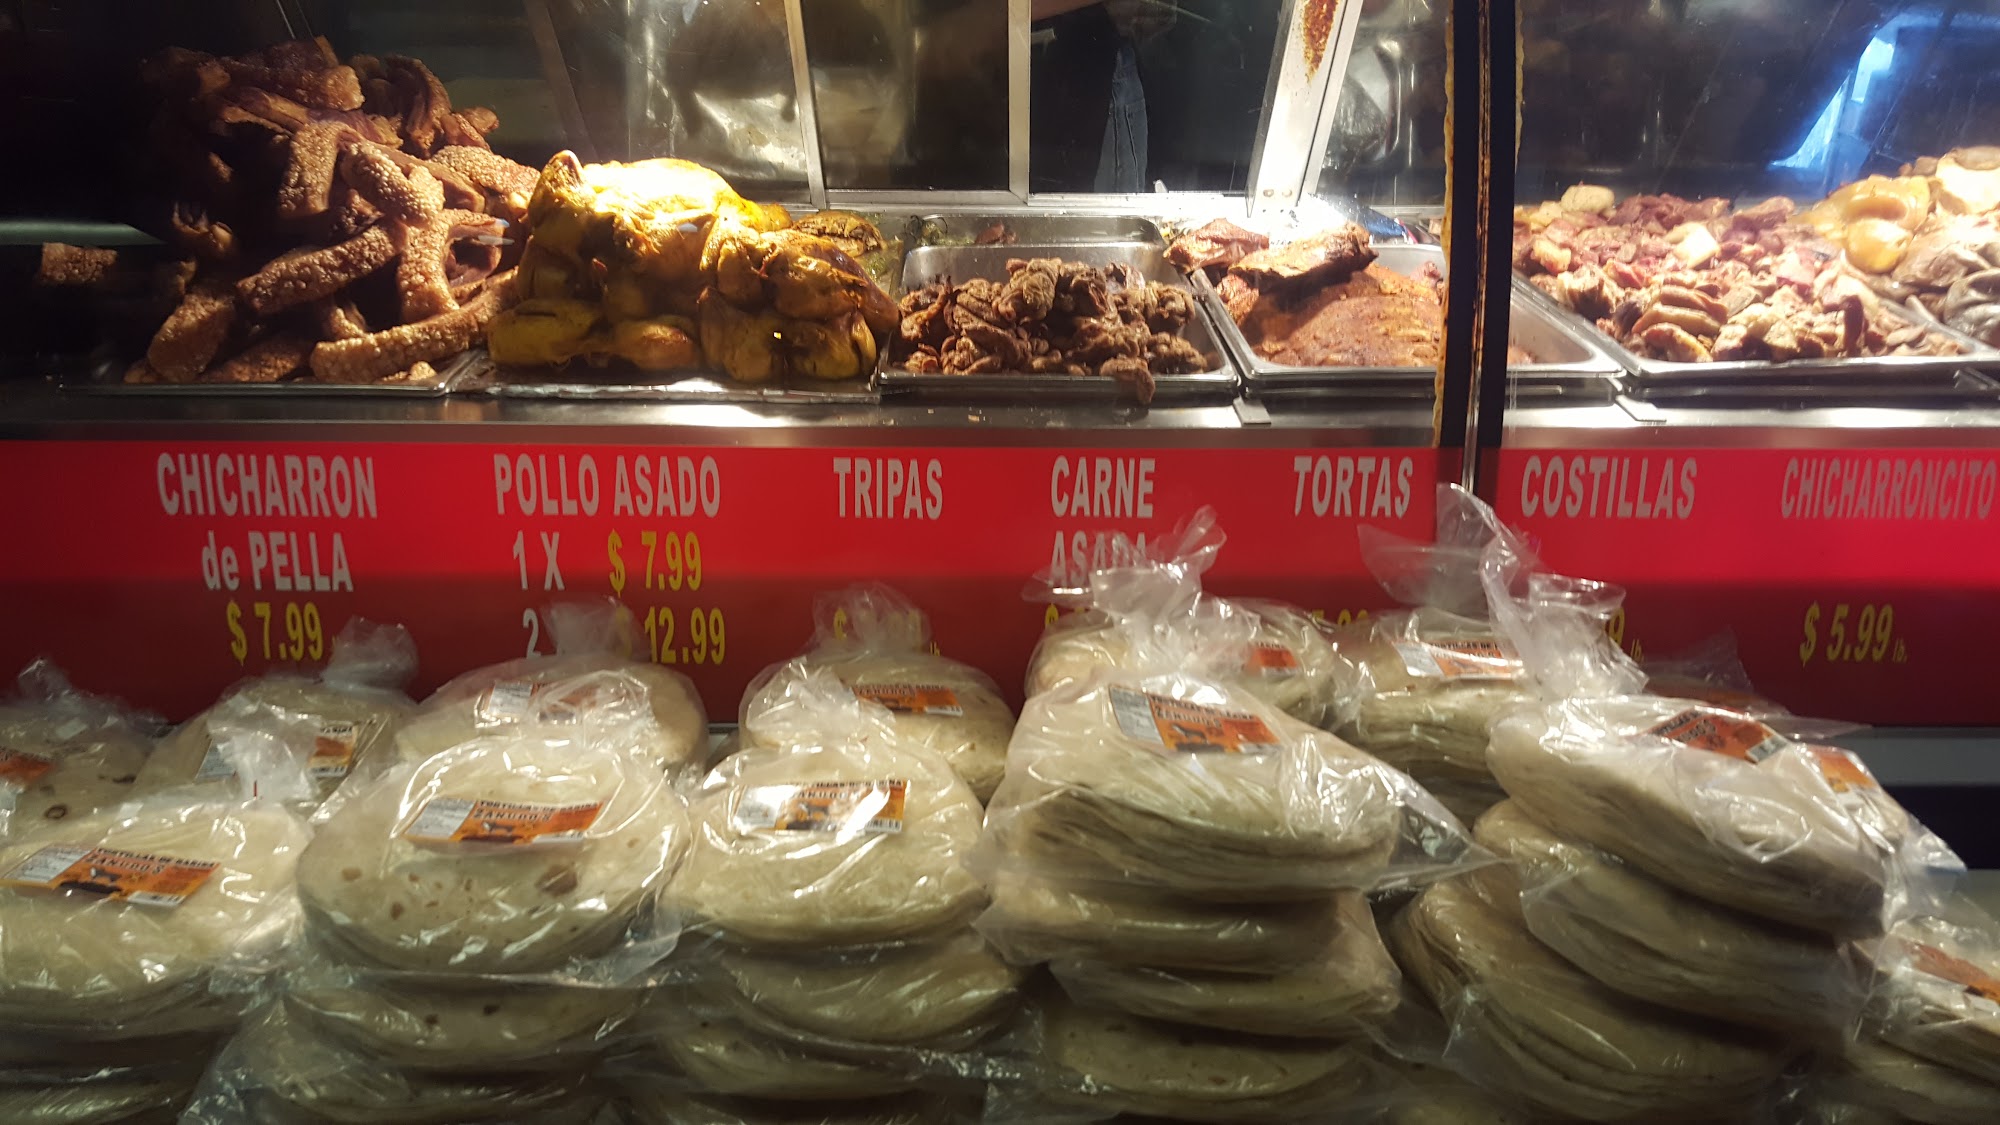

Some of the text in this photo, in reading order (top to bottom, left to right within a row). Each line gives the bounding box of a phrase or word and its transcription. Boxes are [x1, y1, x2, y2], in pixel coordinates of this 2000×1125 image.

[157, 452, 378, 519] CHICHARRON
[493, 453, 721, 518] POLLO ASADO
[833, 457, 943, 520] TRIPAS
[1051, 455, 1155, 519] CARNE
[1293, 455, 1414, 519] TORTAS
[1520, 455, 1698, 520] COSTILLAS
[1781, 457, 1998, 520] CHICHARRONCITO
[201, 530, 354, 592] de PELLA
[513, 528, 702, 599] 1 X $ 7.99
[226, 597, 324, 667] $ 7.99
[522, 607, 542, 660] 2
[644, 606, 726, 665] 12.99
[1799, 600, 1821, 668] $
[1826, 603, 1893, 662] 5.99
